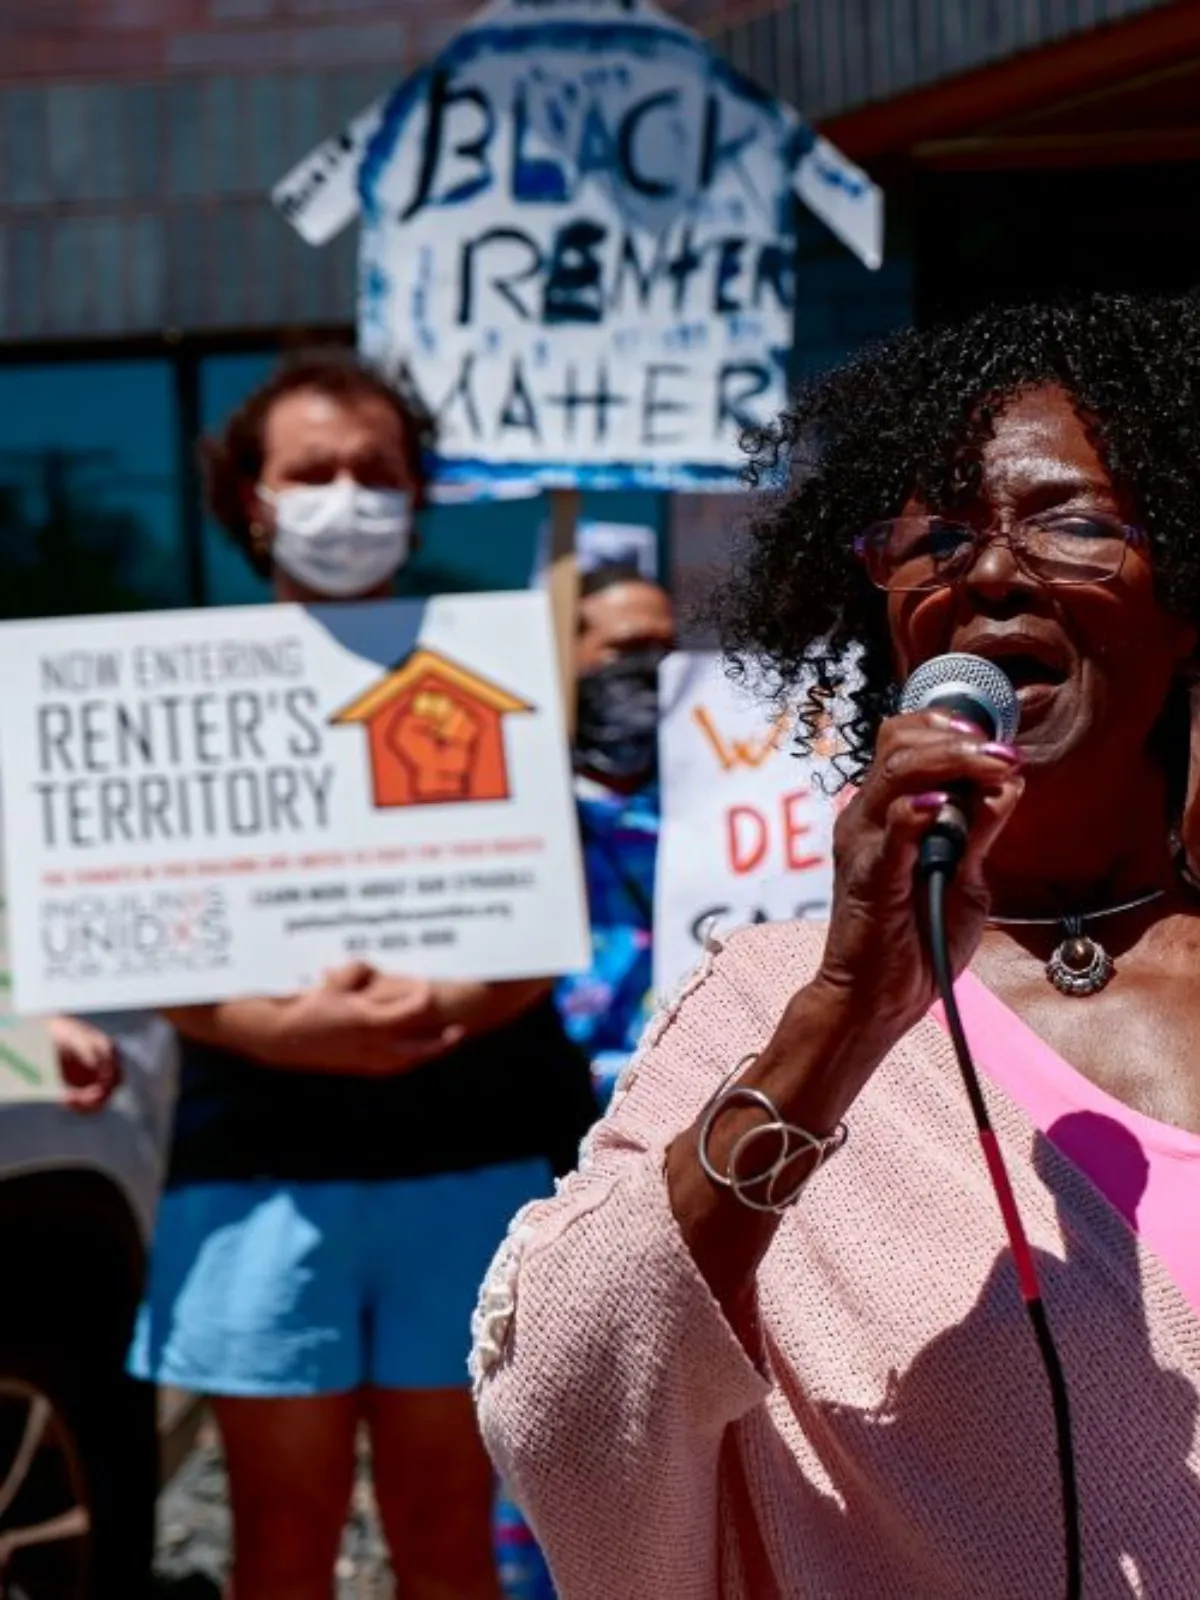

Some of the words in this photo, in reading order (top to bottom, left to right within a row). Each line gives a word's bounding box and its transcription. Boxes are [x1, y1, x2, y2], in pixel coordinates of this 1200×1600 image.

[398, 62, 770, 222] BLACK
[453, 218, 798, 326] RENTER
[38, 650, 119, 693] NOW
[132, 636, 305, 685] ENTERING
[36, 686, 323, 773] RENTER'S
[30, 765, 335, 850] TERRITORY
